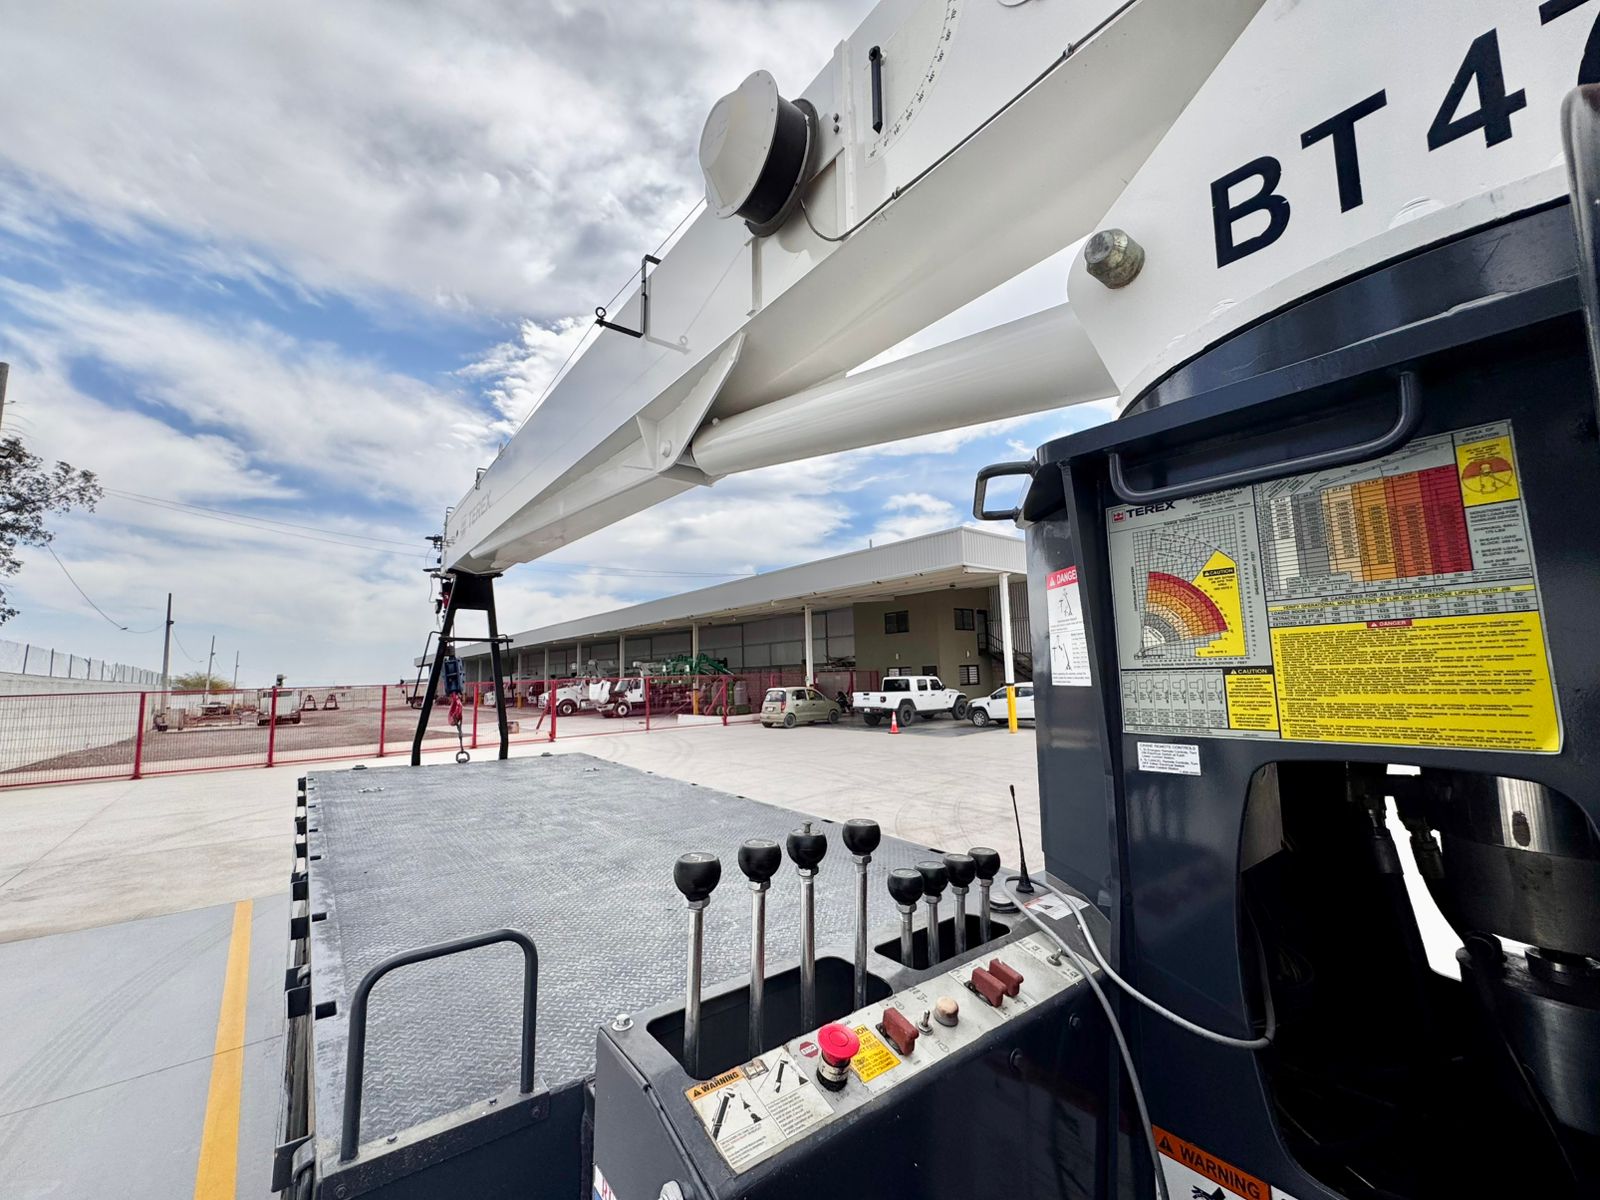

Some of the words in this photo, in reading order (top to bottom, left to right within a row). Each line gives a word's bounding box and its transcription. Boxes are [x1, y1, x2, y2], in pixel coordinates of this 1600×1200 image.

[1210, 88, 1388, 269] BT
[1126, 500, 1176, 518] TEREX
[1056, 570, 1078, 585] DANGE
[1209, 568, 1234, 576] CAUTION
[1180, 1144, 1261, 1199] WARNING
